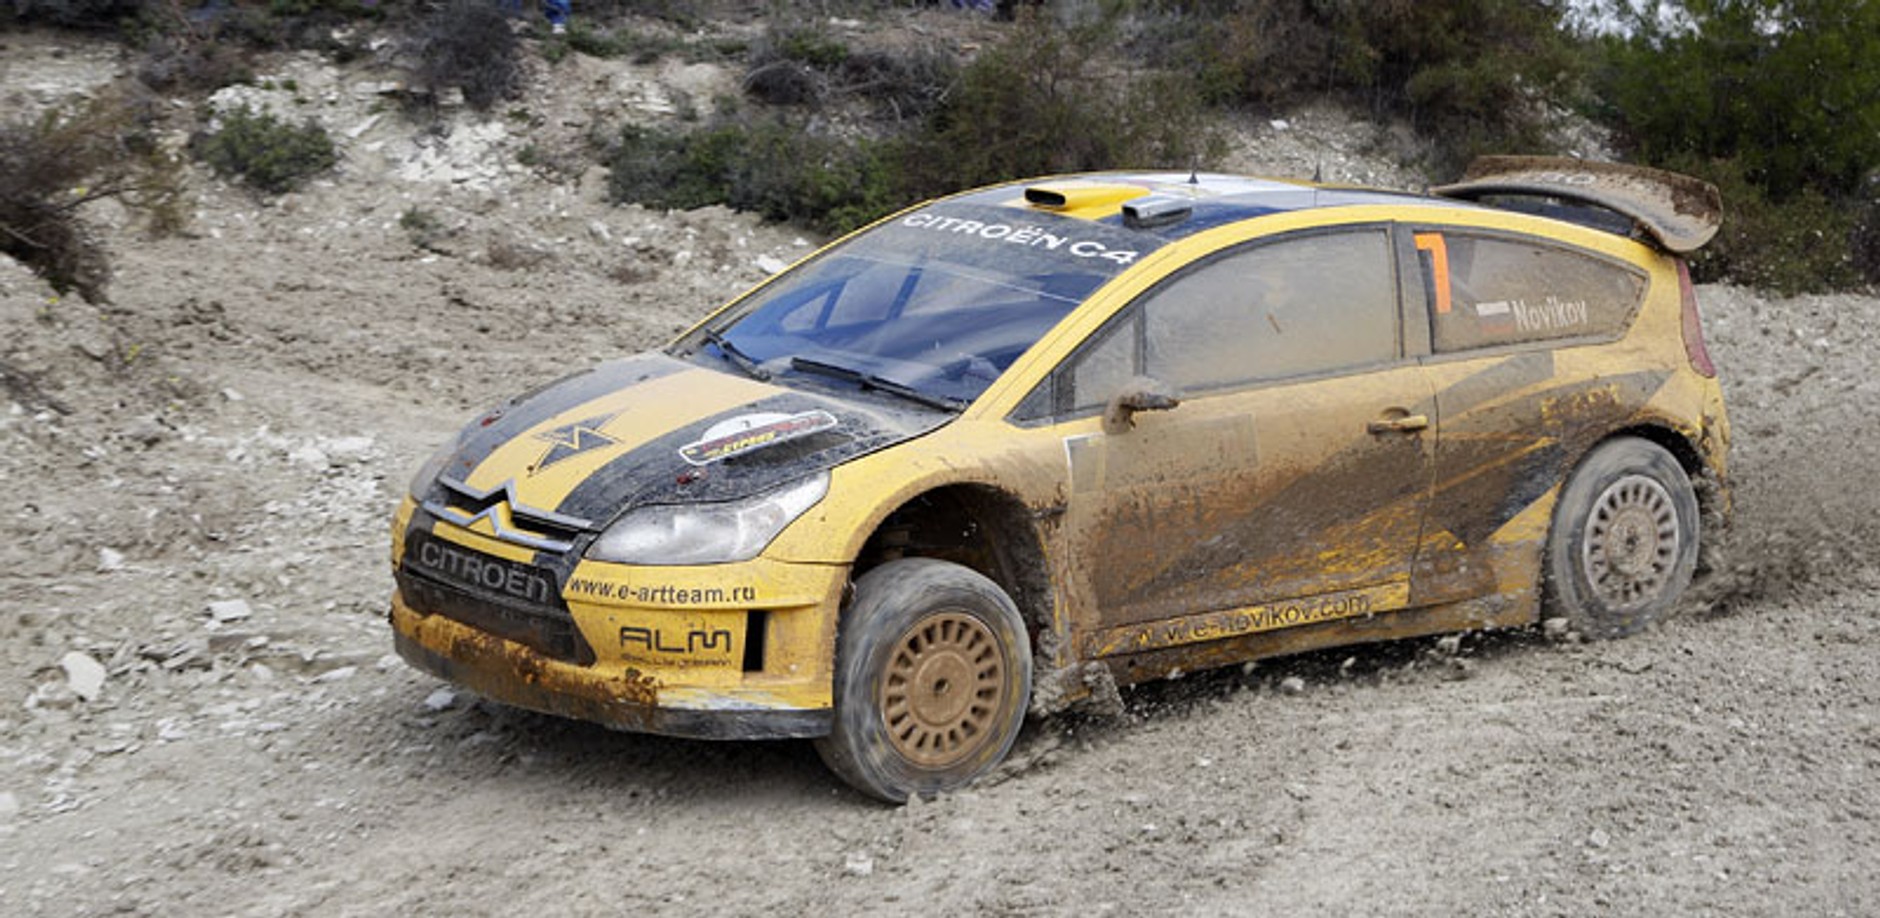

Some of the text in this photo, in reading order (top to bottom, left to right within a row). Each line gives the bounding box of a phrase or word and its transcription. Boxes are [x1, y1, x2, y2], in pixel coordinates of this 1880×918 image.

[902, 212, 1140, 265] CITROËN C4
[1511, 294, 1588, 331] Novikov
[569, 577, 756, 604] www.e-artteam.ru
[619, 626, 732, 654] ALM
